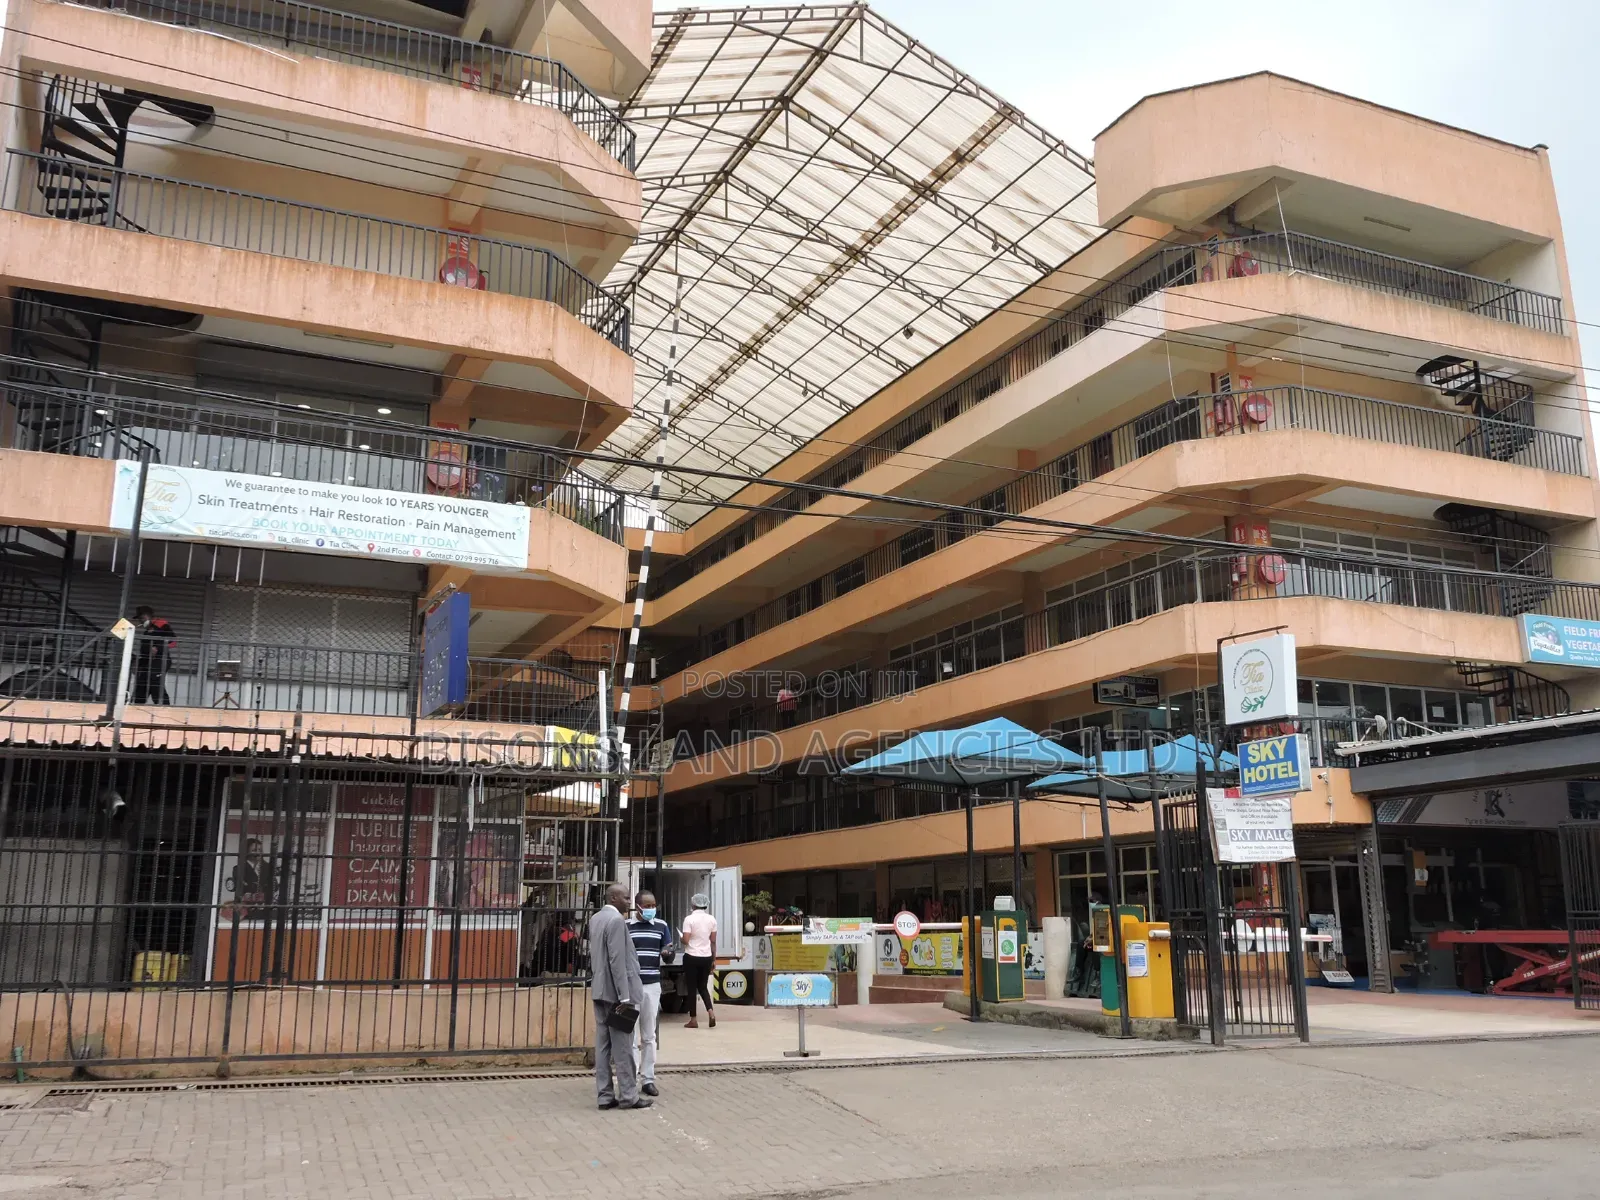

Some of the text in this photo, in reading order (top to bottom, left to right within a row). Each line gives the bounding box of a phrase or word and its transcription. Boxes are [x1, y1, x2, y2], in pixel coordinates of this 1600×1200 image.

[225, 478, 489, 519] We guarantee to make you look 10 YEARS YOUNGER
[197, 494, 516, 541] Skin Treatments Hair Restoration Pain Management
[252, 518, 460, 549] BOOK YOUR APPOINTMENT TODAY
[329, 540, 340, 548] Tia
[377, 545, 391, 554] 2nd
[392, 546, 410, 556] Floor
[426, 550, 454, 560] Contact:
[454, 553, 472, 563] 0799
[1563, 625, 1587, 637] FIELD
[1247, 737, 1288, 764] SKY
[1243, 760, 1299, 784] HOTEL
[351, 822, 418, 839] JUBILEE
[1231, 829, 1284, 841] SKY MALL
[349, 858, 416, 874] CLAIMS
[347, 889, 415, 903] DRAM!
[897, 921, 917, 929] STOP
[726, 980, 744, 989] EXIT
[795, 980, 809, 994] Sky
